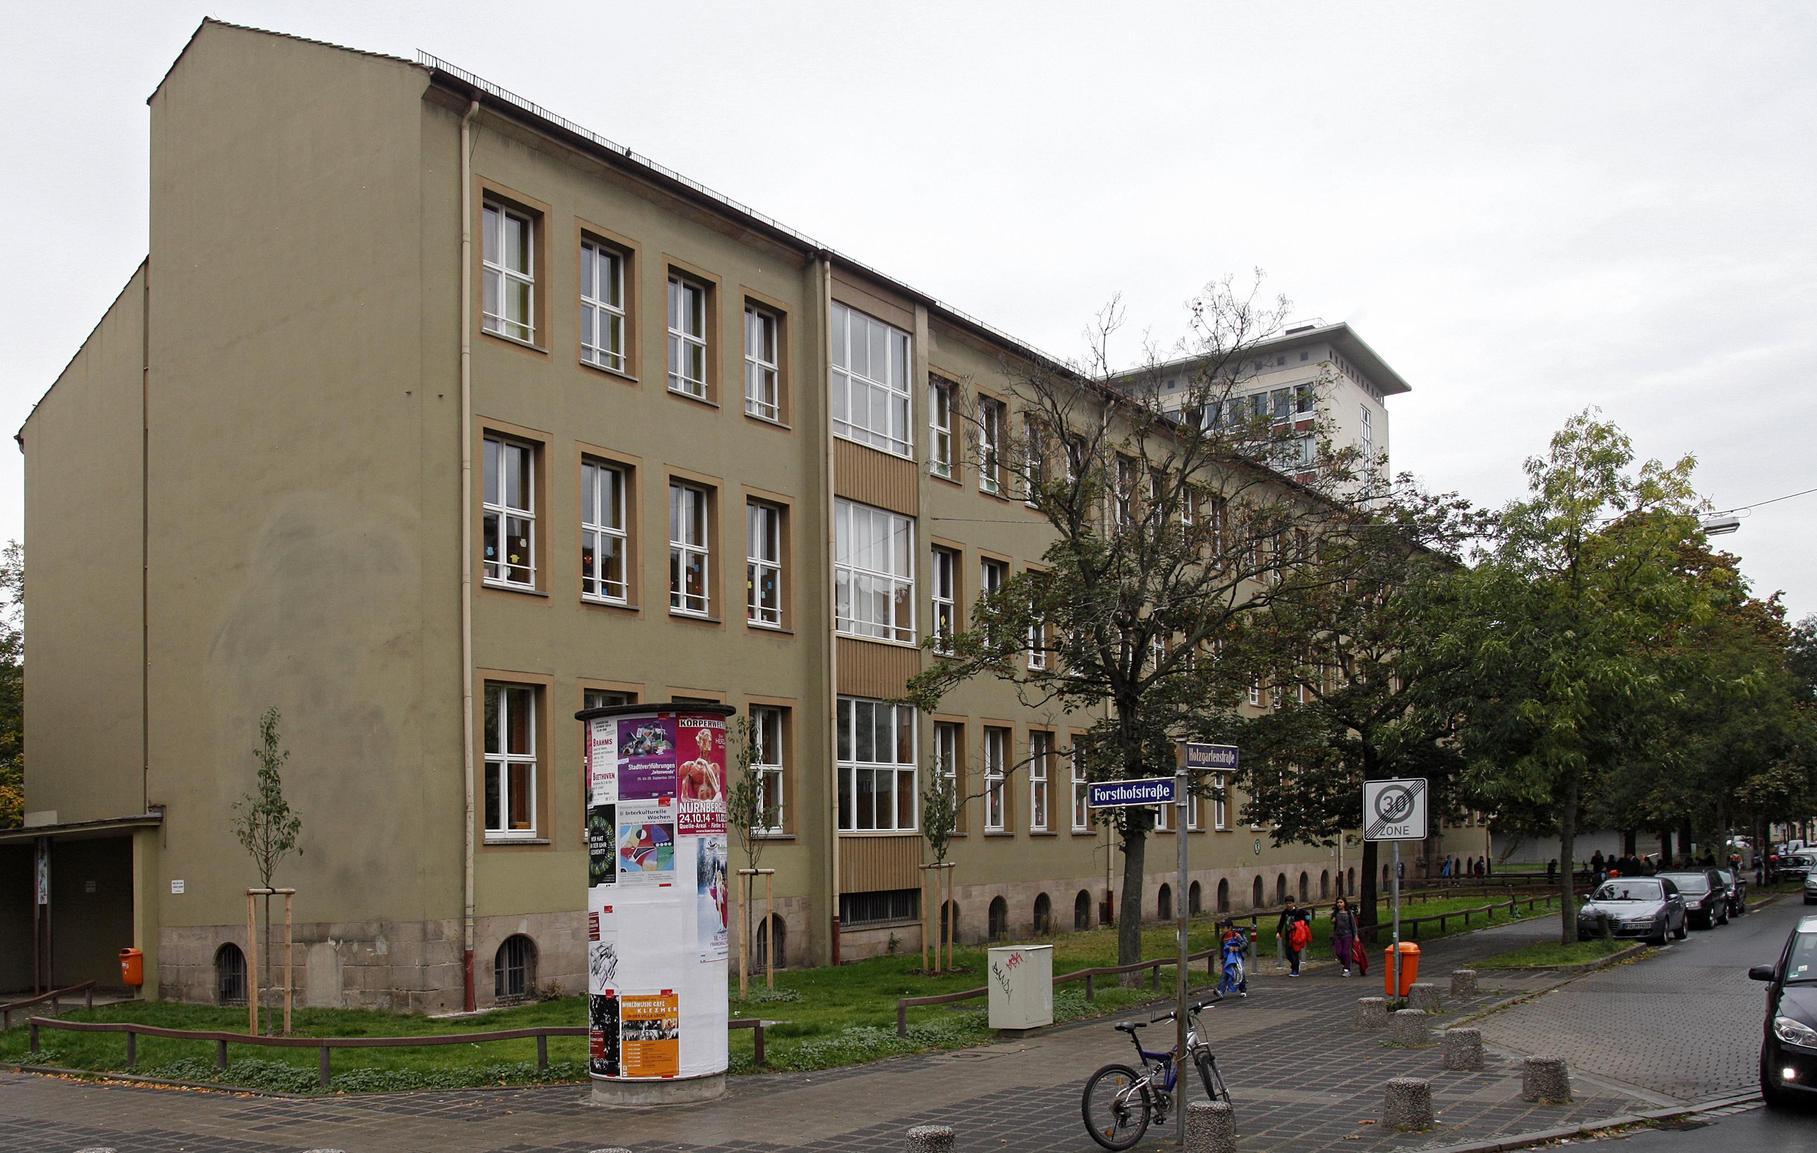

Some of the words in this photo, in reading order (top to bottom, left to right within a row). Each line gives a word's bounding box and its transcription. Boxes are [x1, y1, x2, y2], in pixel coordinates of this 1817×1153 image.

[593, 738, 613, 747] BRAHMS
[1188, 746, 1235, 765] Holzgartenstraße
[593, 773, 615, 781] BEETHOVEN
[1094, 783, 1170, 801] Forsthofstraße
[1383, 795, 1407, 812] 30
[679, 813, 710, 823] 24.10.14
[1380, 826, 1410, 836] ZONE
